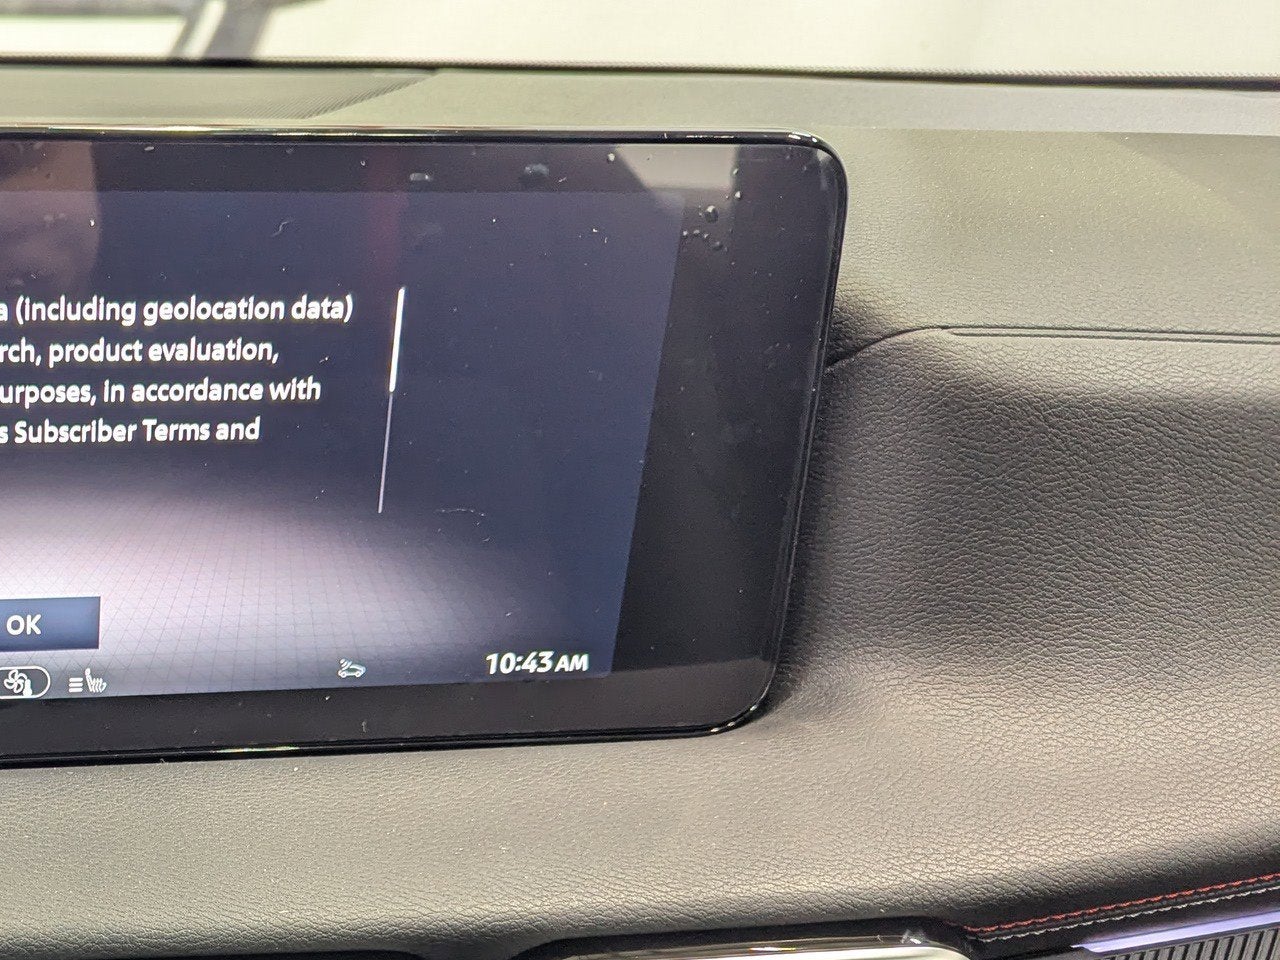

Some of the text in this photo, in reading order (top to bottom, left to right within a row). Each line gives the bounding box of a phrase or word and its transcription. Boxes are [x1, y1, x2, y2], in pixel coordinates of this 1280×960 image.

[16, 295, 136, 326] (including
[143, 295, 285, 326] geolocation
[292, 294, 353, 322] data)
[49, 337, 143, 368] product
[149, 336, 278, 363] evaluation,
[104, 380, 125, 402] in
[132, 377, 263, 402] accordance
[269, 376, 321, 400] with
[15, 418, 137, 443] Subscriber
[142, 419, 210, 441] Terms
[216, 416, 260, 440] and
[7, 614, 41, 635] OK
[486, 651, 588, 674] 10:43 AM
